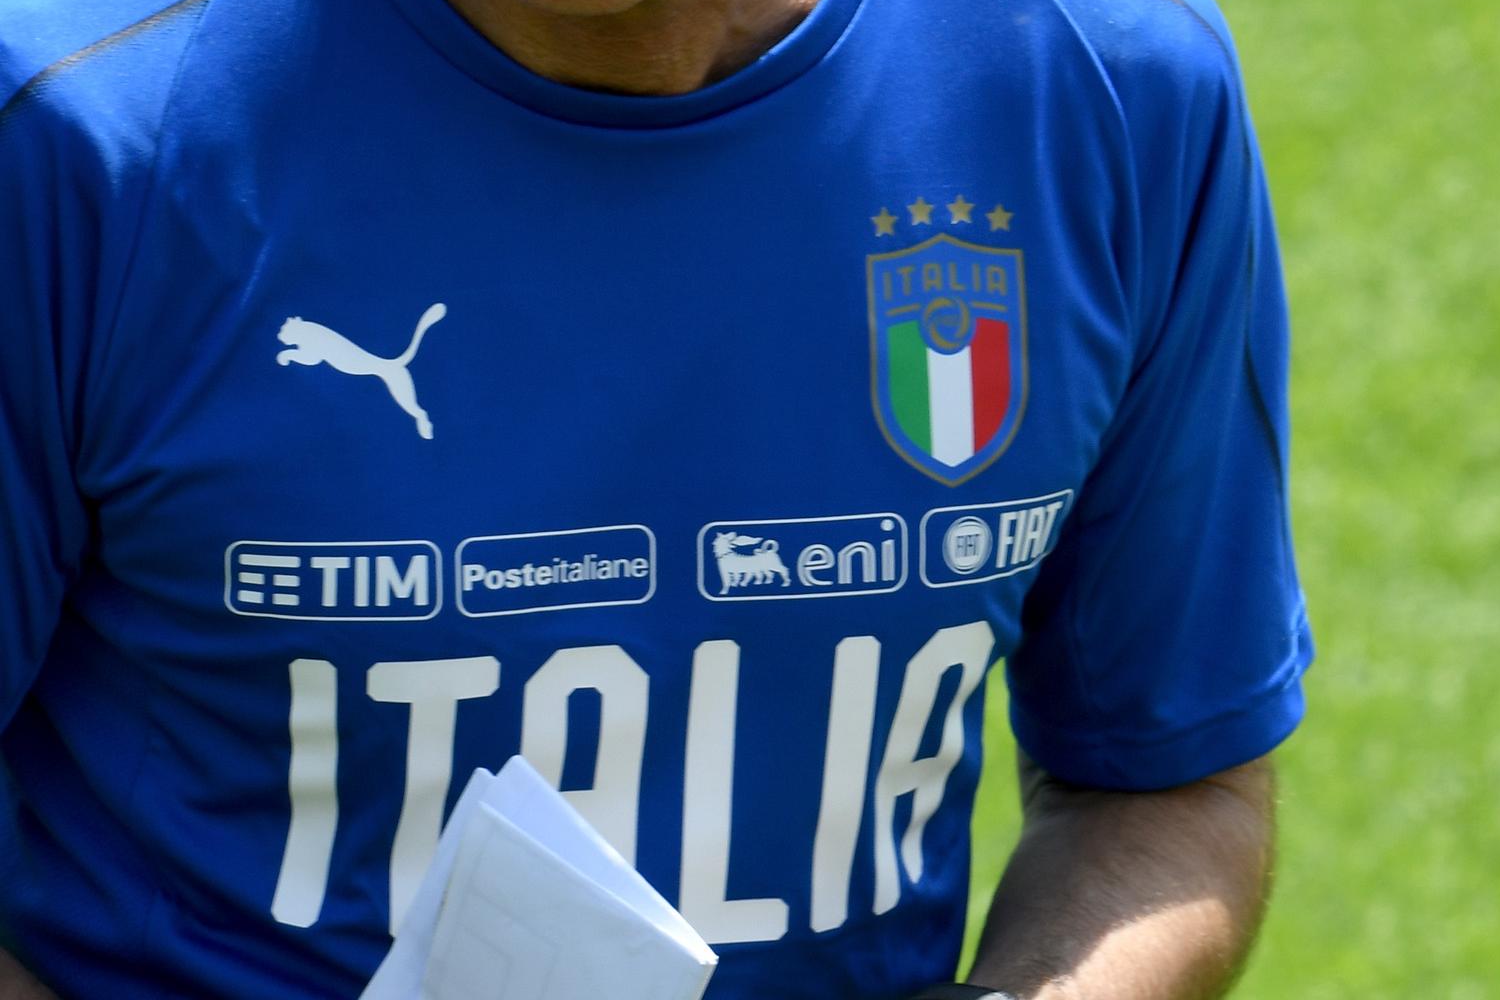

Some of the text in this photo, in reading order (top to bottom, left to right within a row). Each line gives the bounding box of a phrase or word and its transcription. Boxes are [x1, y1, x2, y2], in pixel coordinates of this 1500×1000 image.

[882, 261, 1008, 300] ITALIA
[796, 518, 896, 587] eni
[995, 500, 1064, 569] FIAT
[310, 554, 429, 607] TIM
[462, 554, 649, 592] Posteitaliane
[271, 620, 996, 944] ITALIA
